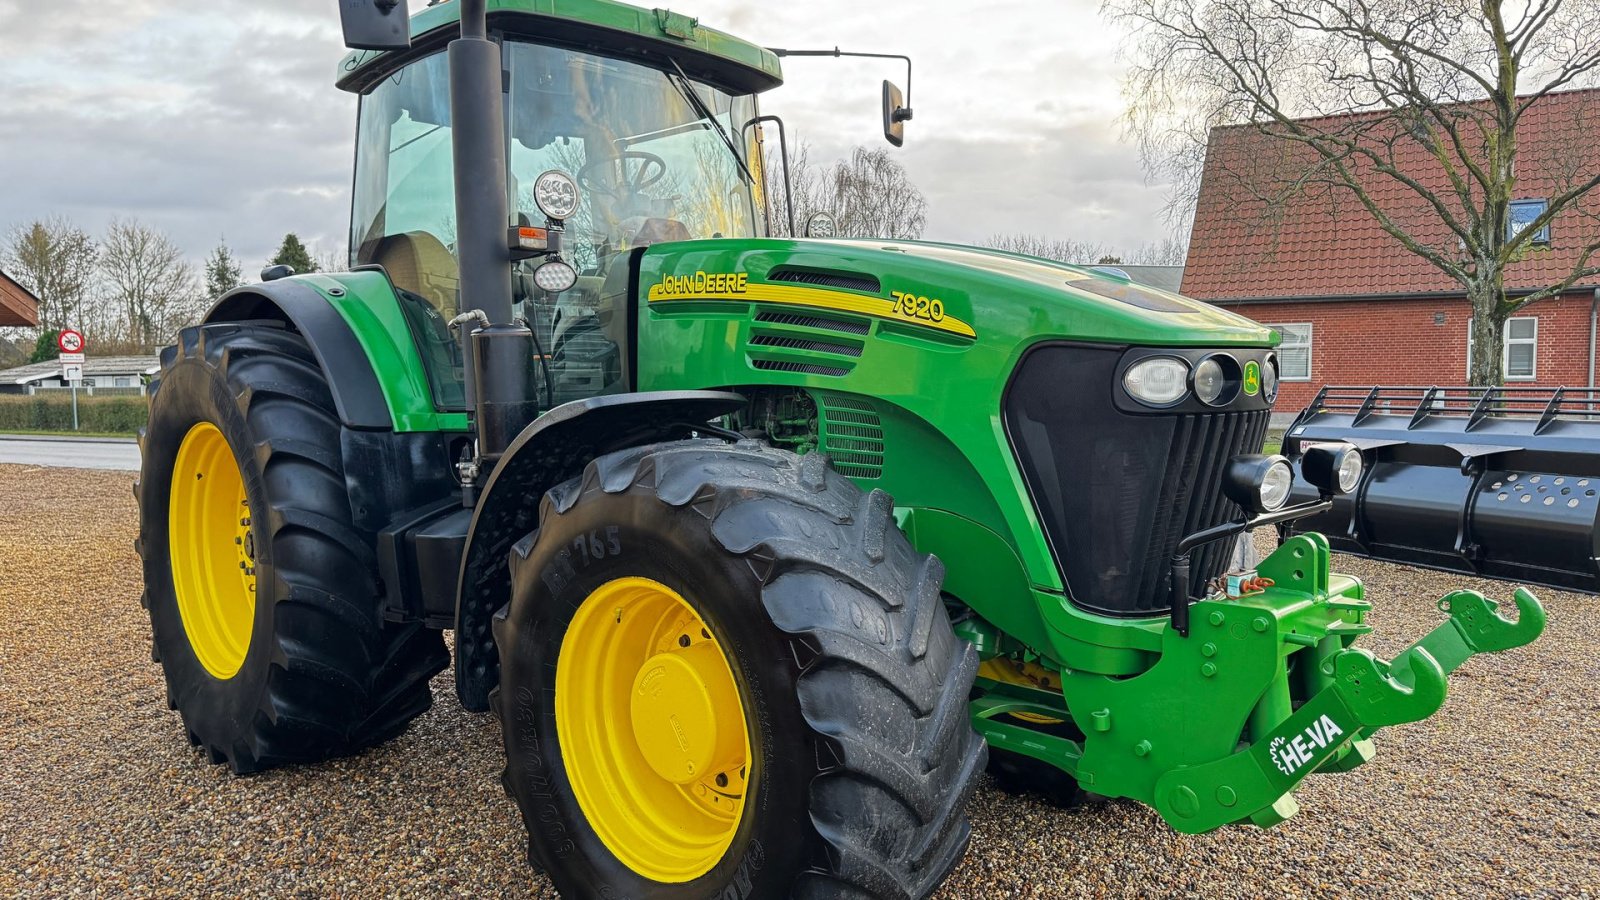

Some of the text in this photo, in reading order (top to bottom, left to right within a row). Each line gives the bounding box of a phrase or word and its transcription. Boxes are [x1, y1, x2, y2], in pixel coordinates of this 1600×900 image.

[658, 270, 748, 295] JOHN DEERE
[890, 290, 945, 323] 7920
[573, 525, 622, 568] 765
[1278, 713, 1344, 774] HE-VA
